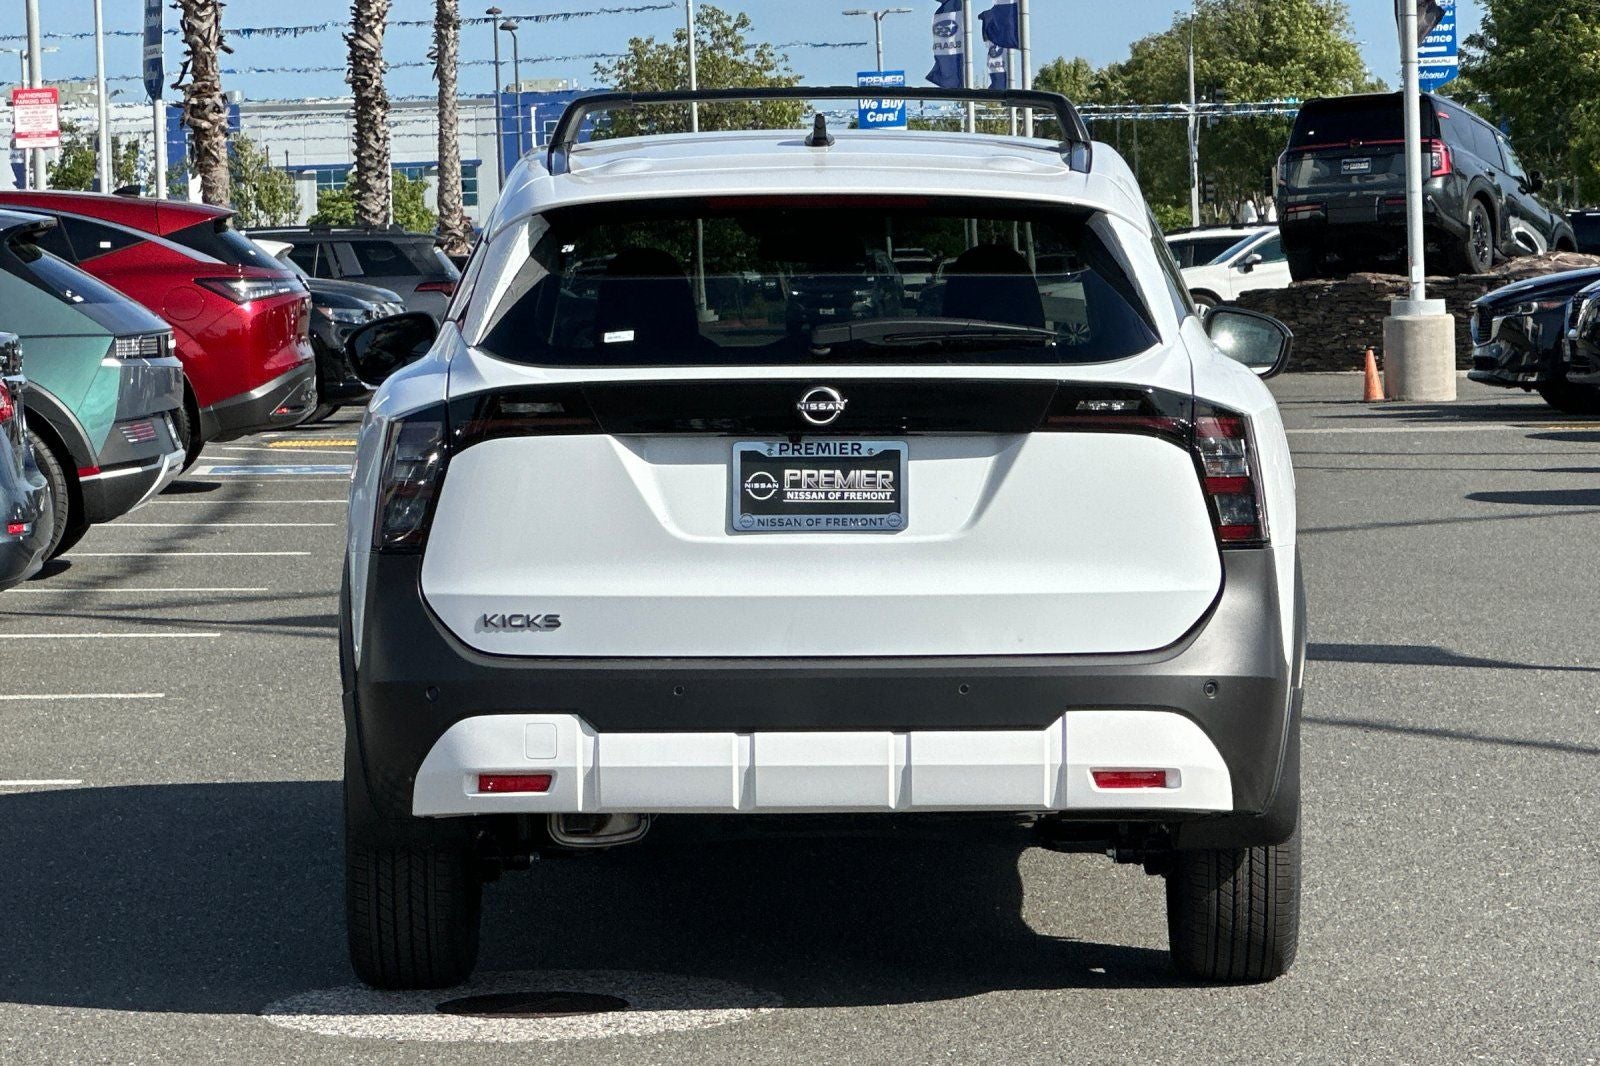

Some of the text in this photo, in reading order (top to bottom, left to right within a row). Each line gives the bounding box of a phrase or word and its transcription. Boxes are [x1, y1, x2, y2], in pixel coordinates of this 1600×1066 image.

[1418, 69, 1449, 78] elcome!
[858, 75, 904, 84] PREMIER
[860, 99, 904, 111] We Buy
[866, 110, 899, 122] Cars!
[797, 402, 845, 410] NISSAN
[778, 442, 862, 455] PREMIER
[784, 469, 894, 489] PREMIER
[786, 491, 892, 500] NISSAN OF FREMONT
[757, 518, 802, 527] NISSAN
[805, 517, 822, 527] OF
[825, 517, 885, 527] FREMONT
[483, 613, 562, 628] KICKS
